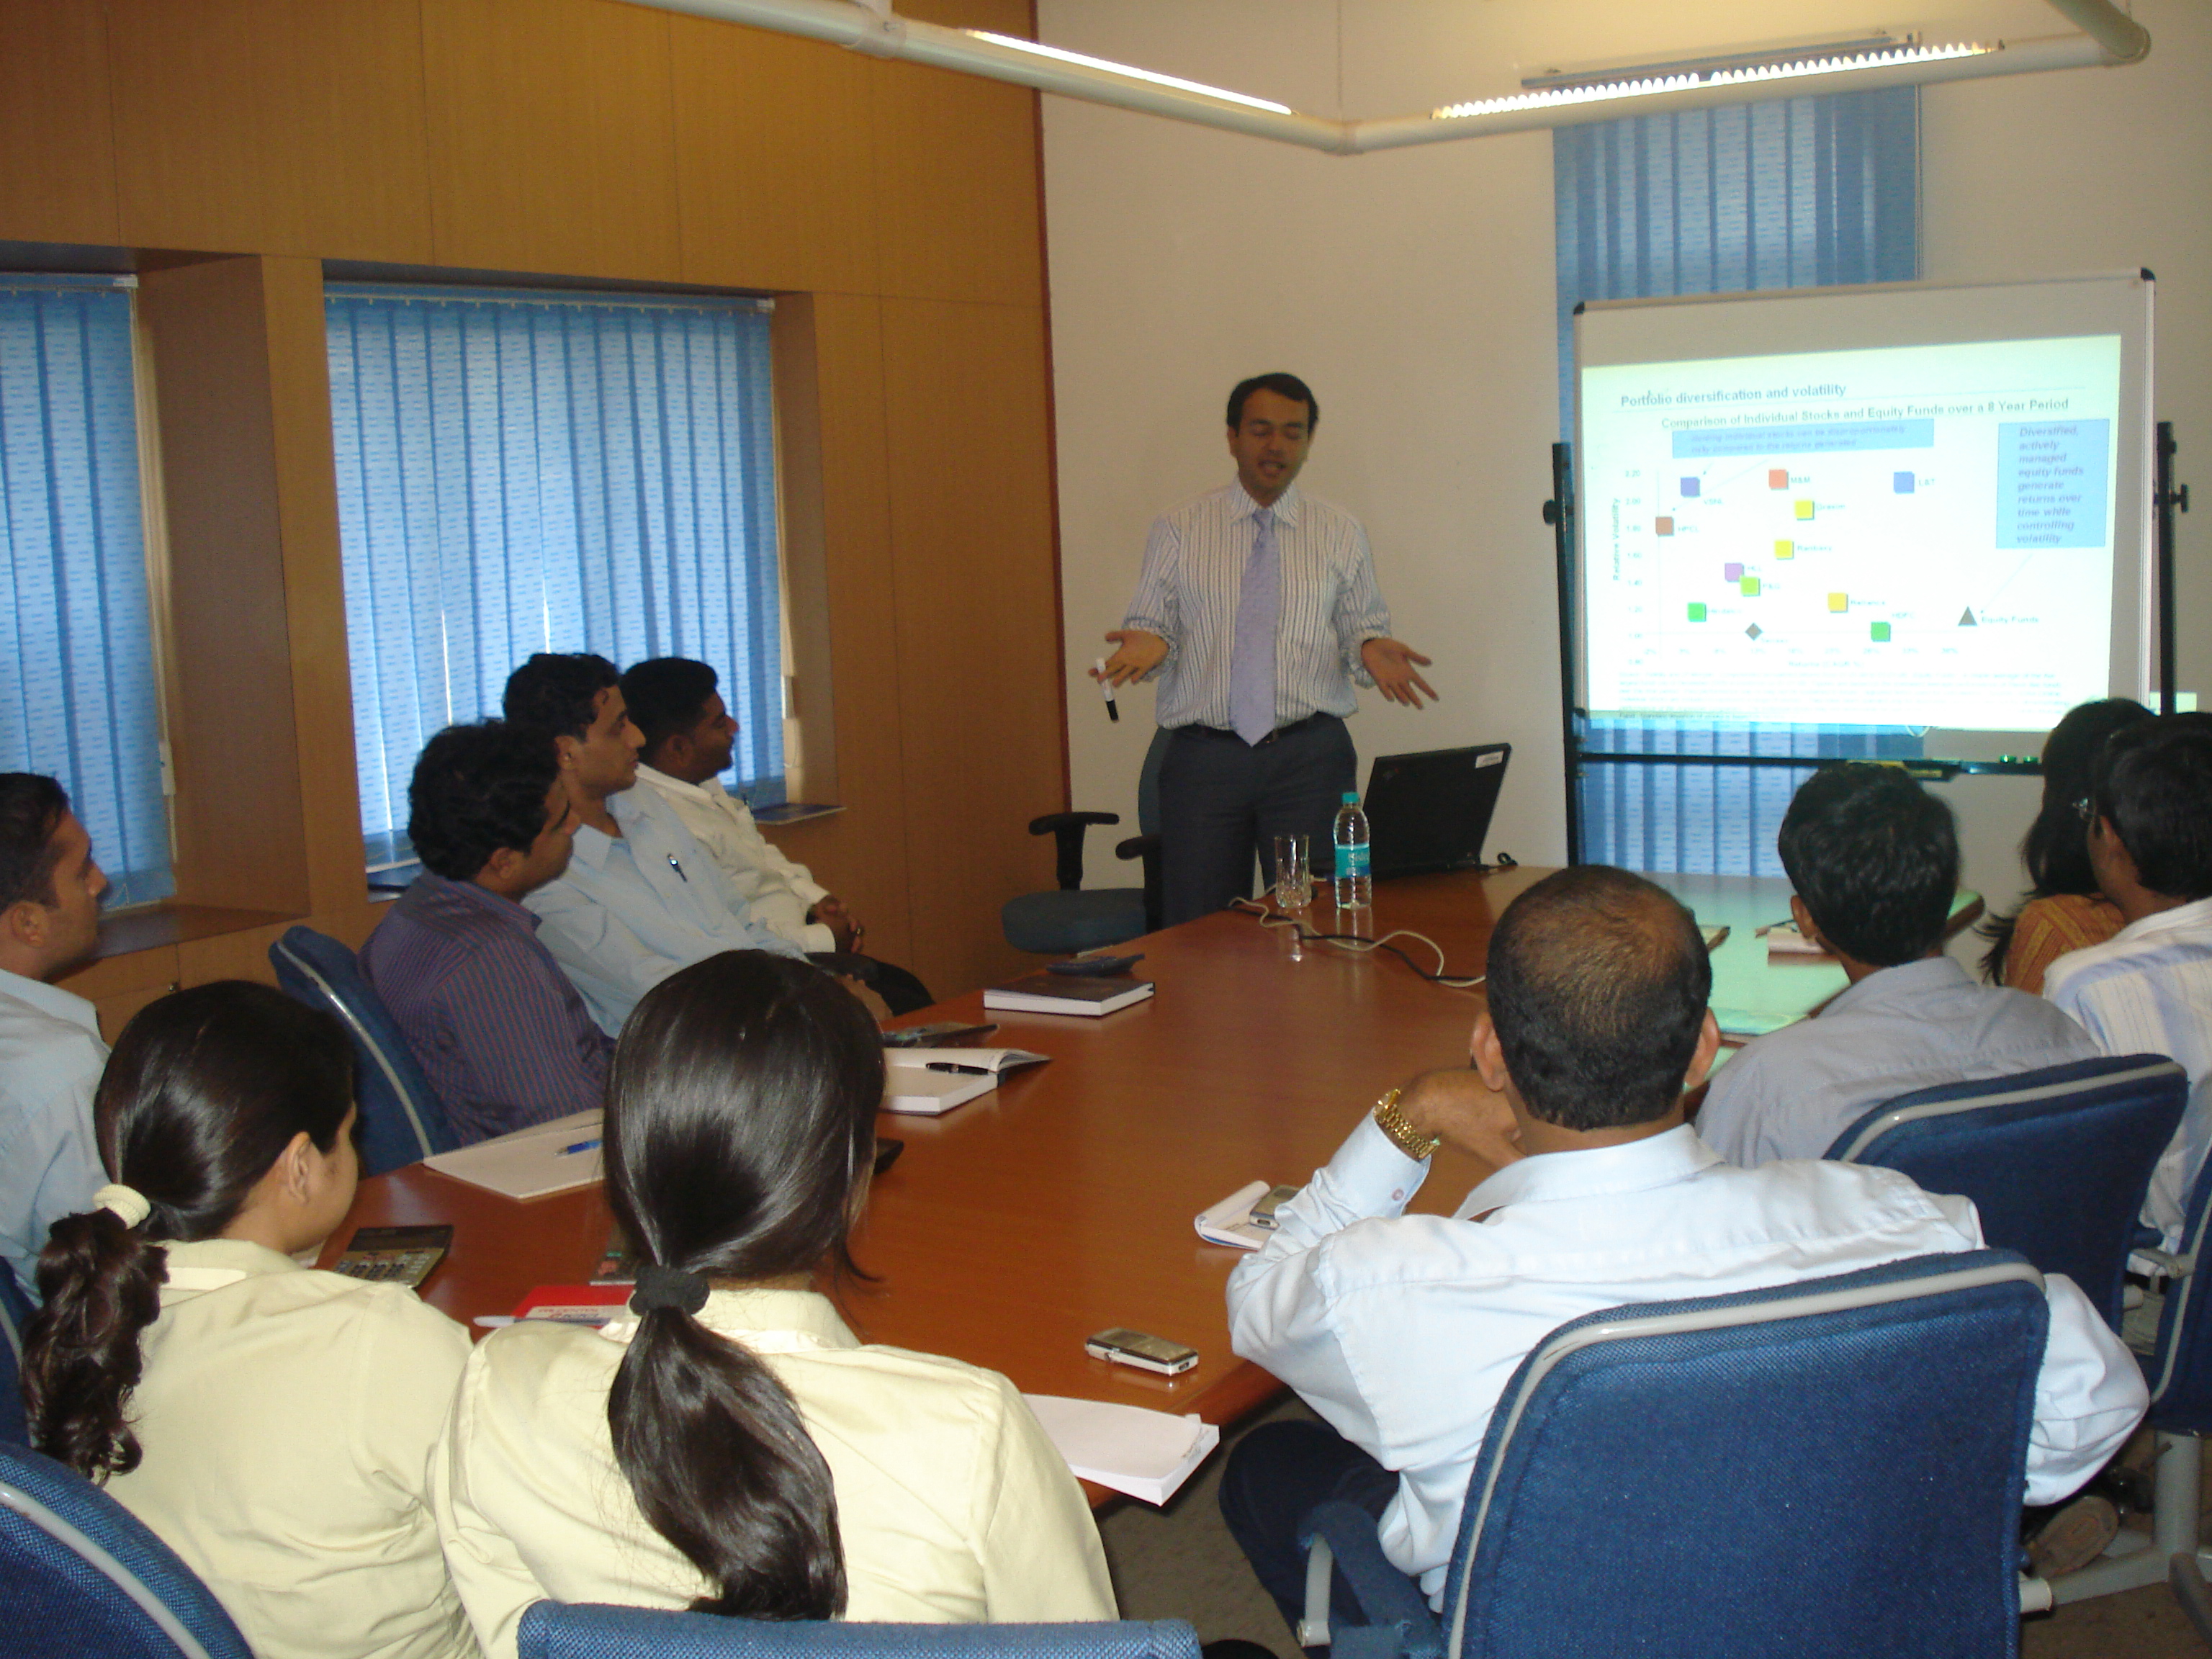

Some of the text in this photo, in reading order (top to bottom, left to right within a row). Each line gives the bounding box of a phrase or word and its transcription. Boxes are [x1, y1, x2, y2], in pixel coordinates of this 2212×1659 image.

[1621, 384, 1846, 407] Portfolio diversification and volatility
[1662, 415, 1728, 430] Comparison
[1730, 414, 1740, 426] of
[1745, 411, 1798, 424] Individual
[1802, 410, 1839, 421] Stocks
[1844, 407, 1863, 418] and
[1868, 406, 1903, 420] Equity
[1908, 404, 1944, 417] Funds
[1948, 405, 1974, 415] over
[1988, 402, 1995, 413] 8
[1999, 400, 2024, 412] Year
[2030, 398, 2069, 410] Period
[2019, 424, 2078, 437] Diversified,
[2019, 439, 2060, 451] actively
[2019, 452, 2067, 464] managed
[2018, 466, 2085, 479] equity funds
[2018, 480, 2064, 493] generate
[2018, 494, 2082, 504] returns over
[2018, 506, 2072, 518] time while
[2017, 520, 2075, 532] controlling
[2017, 533, 2062, 545] volatility
